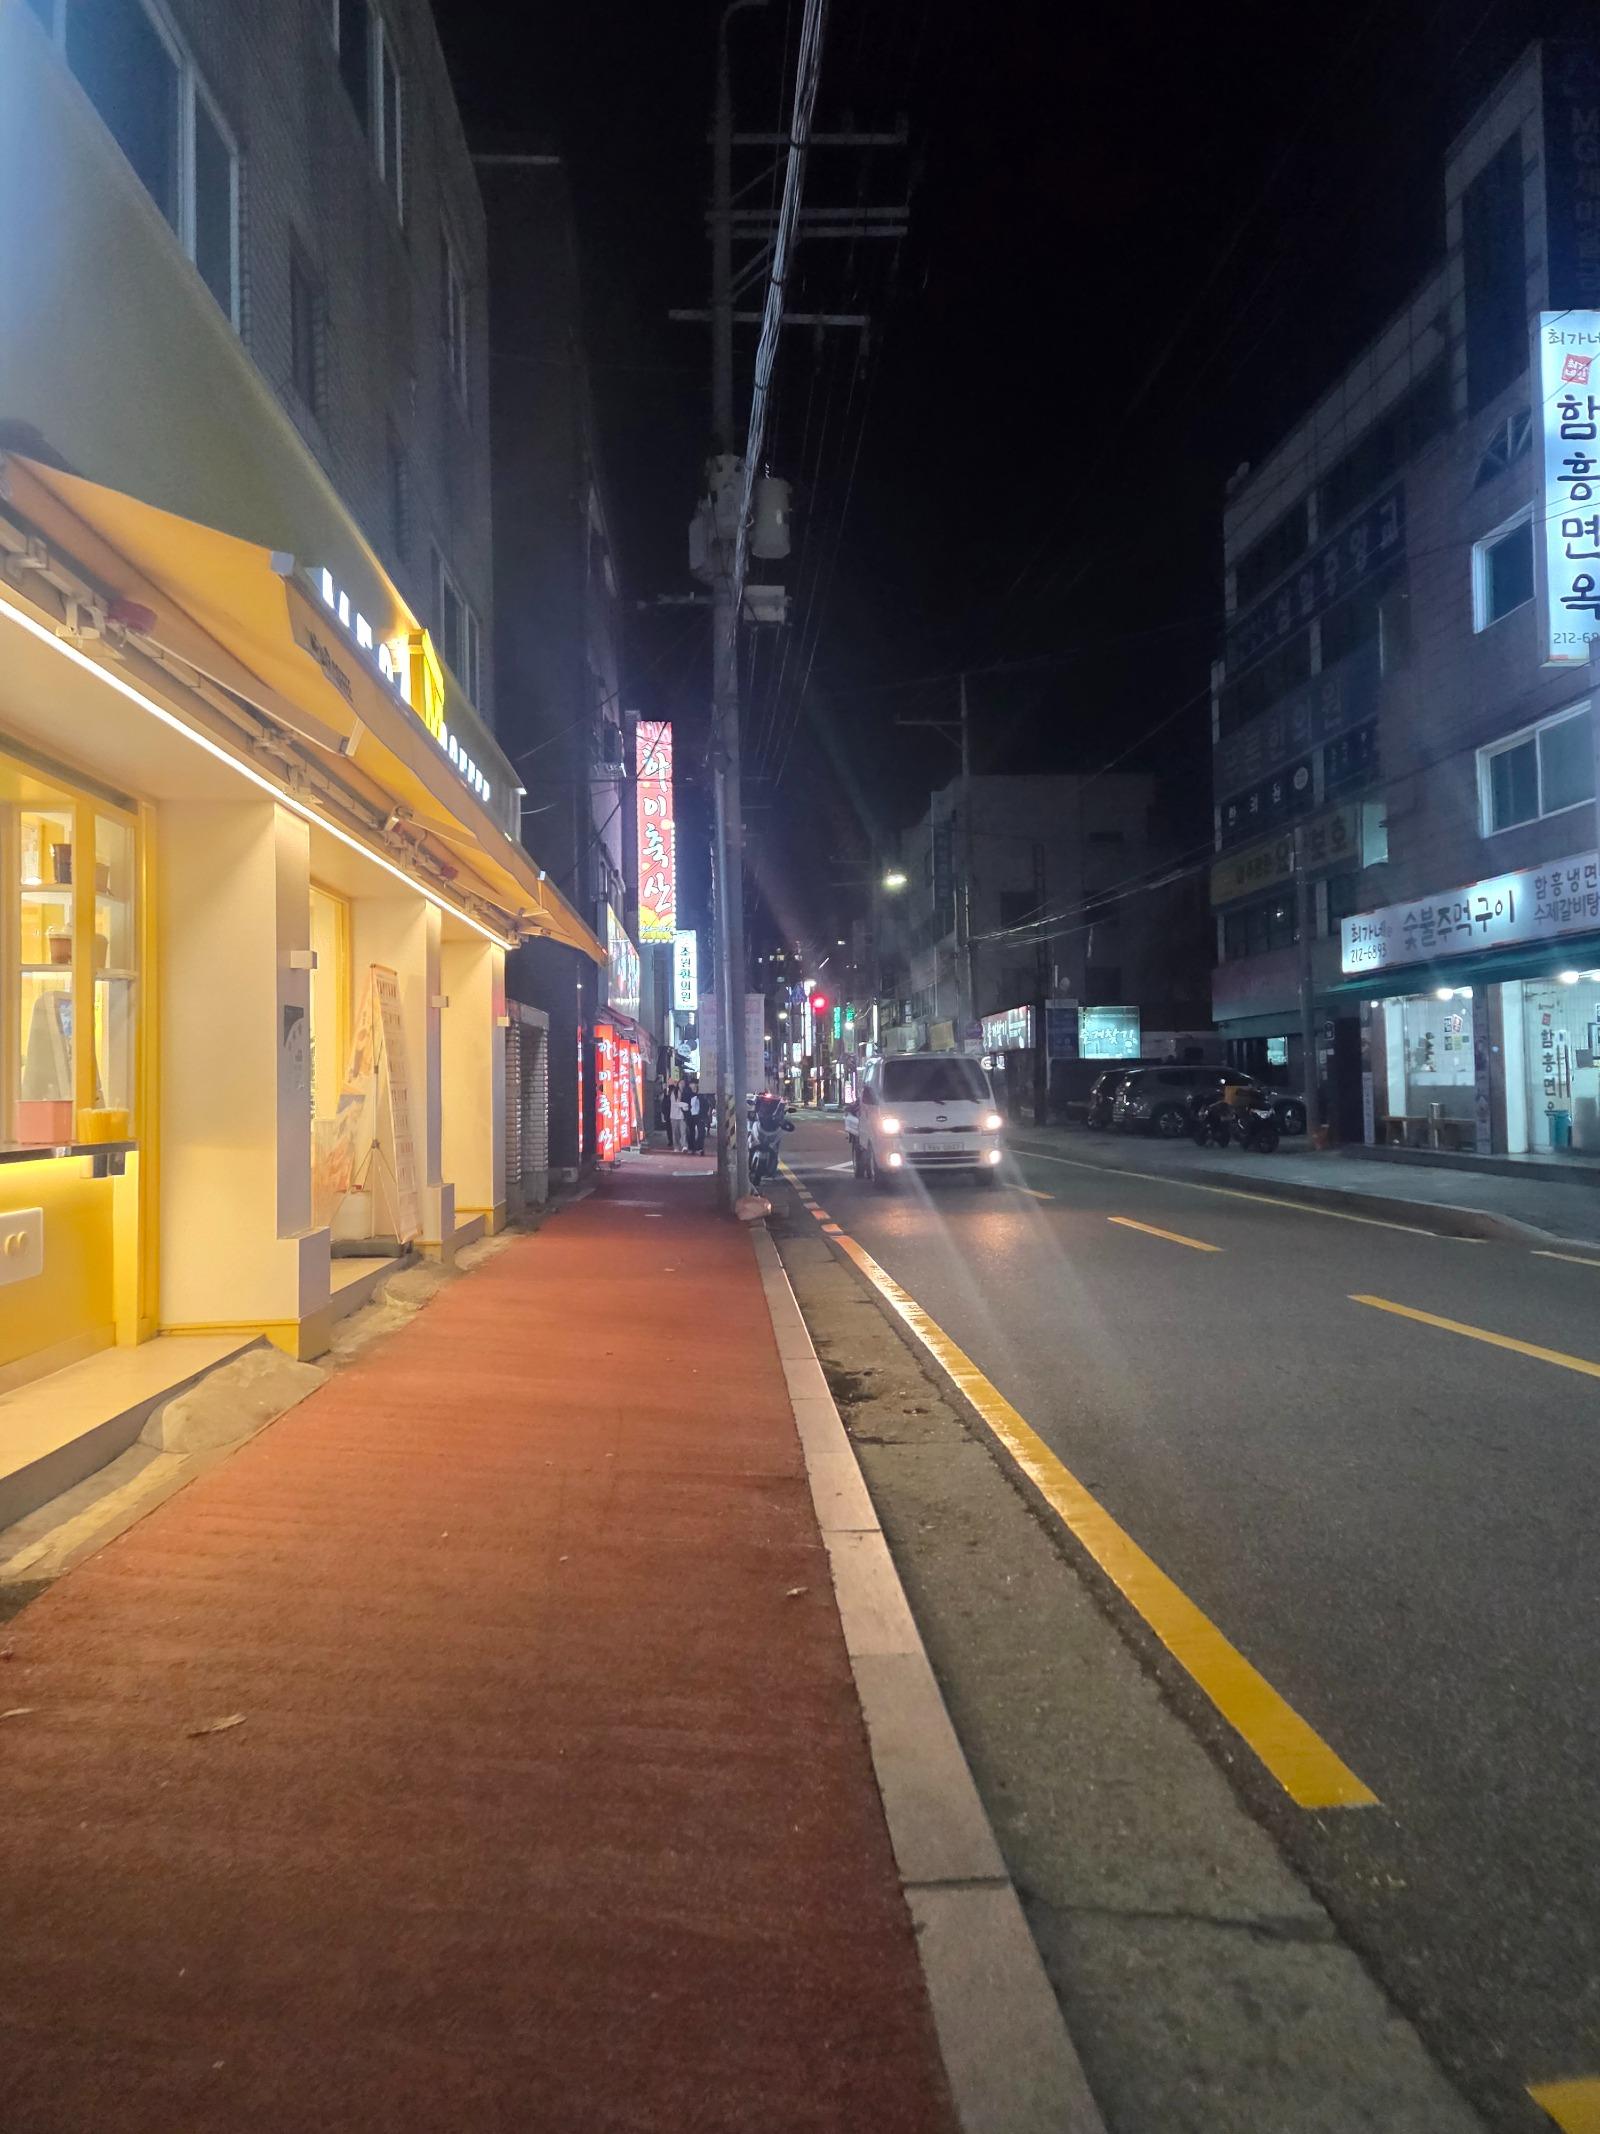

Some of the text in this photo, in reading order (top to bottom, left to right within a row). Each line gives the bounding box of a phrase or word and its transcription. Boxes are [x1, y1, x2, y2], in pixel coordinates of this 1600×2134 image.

[642, 743, 672, 913] 하미축산
[1534, 863, 1597, 900] 함흥냉면
[1403, 890, 1515, 951] 숯불주먹구이
[1533, 891, 1600, 925] 수제갈비탕
[1351, 920, 1387, 943] 최가네
[1351, 943, 1387, 963] 212-6893
[598, 1038, 614, 1151] 하미축산
